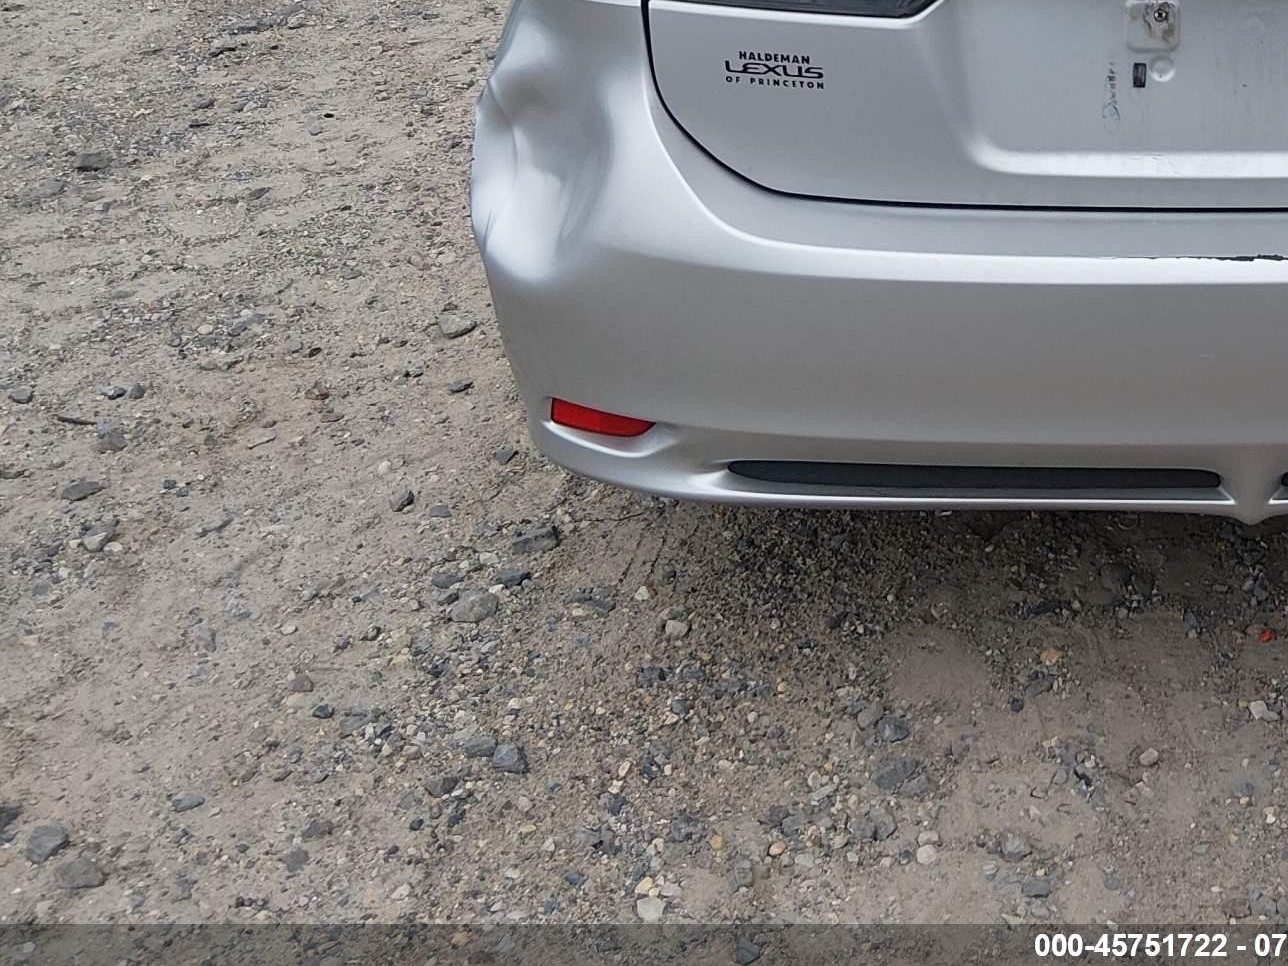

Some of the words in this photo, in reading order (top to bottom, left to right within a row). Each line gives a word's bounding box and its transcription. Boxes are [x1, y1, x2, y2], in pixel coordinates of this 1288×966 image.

[738, 50, 810, 64] HALDEMAN
[725, 60, 824, 79] LEXUS
[725, 75, 741, 83] OF
[750, 77, 824, 90] PRINCETON
